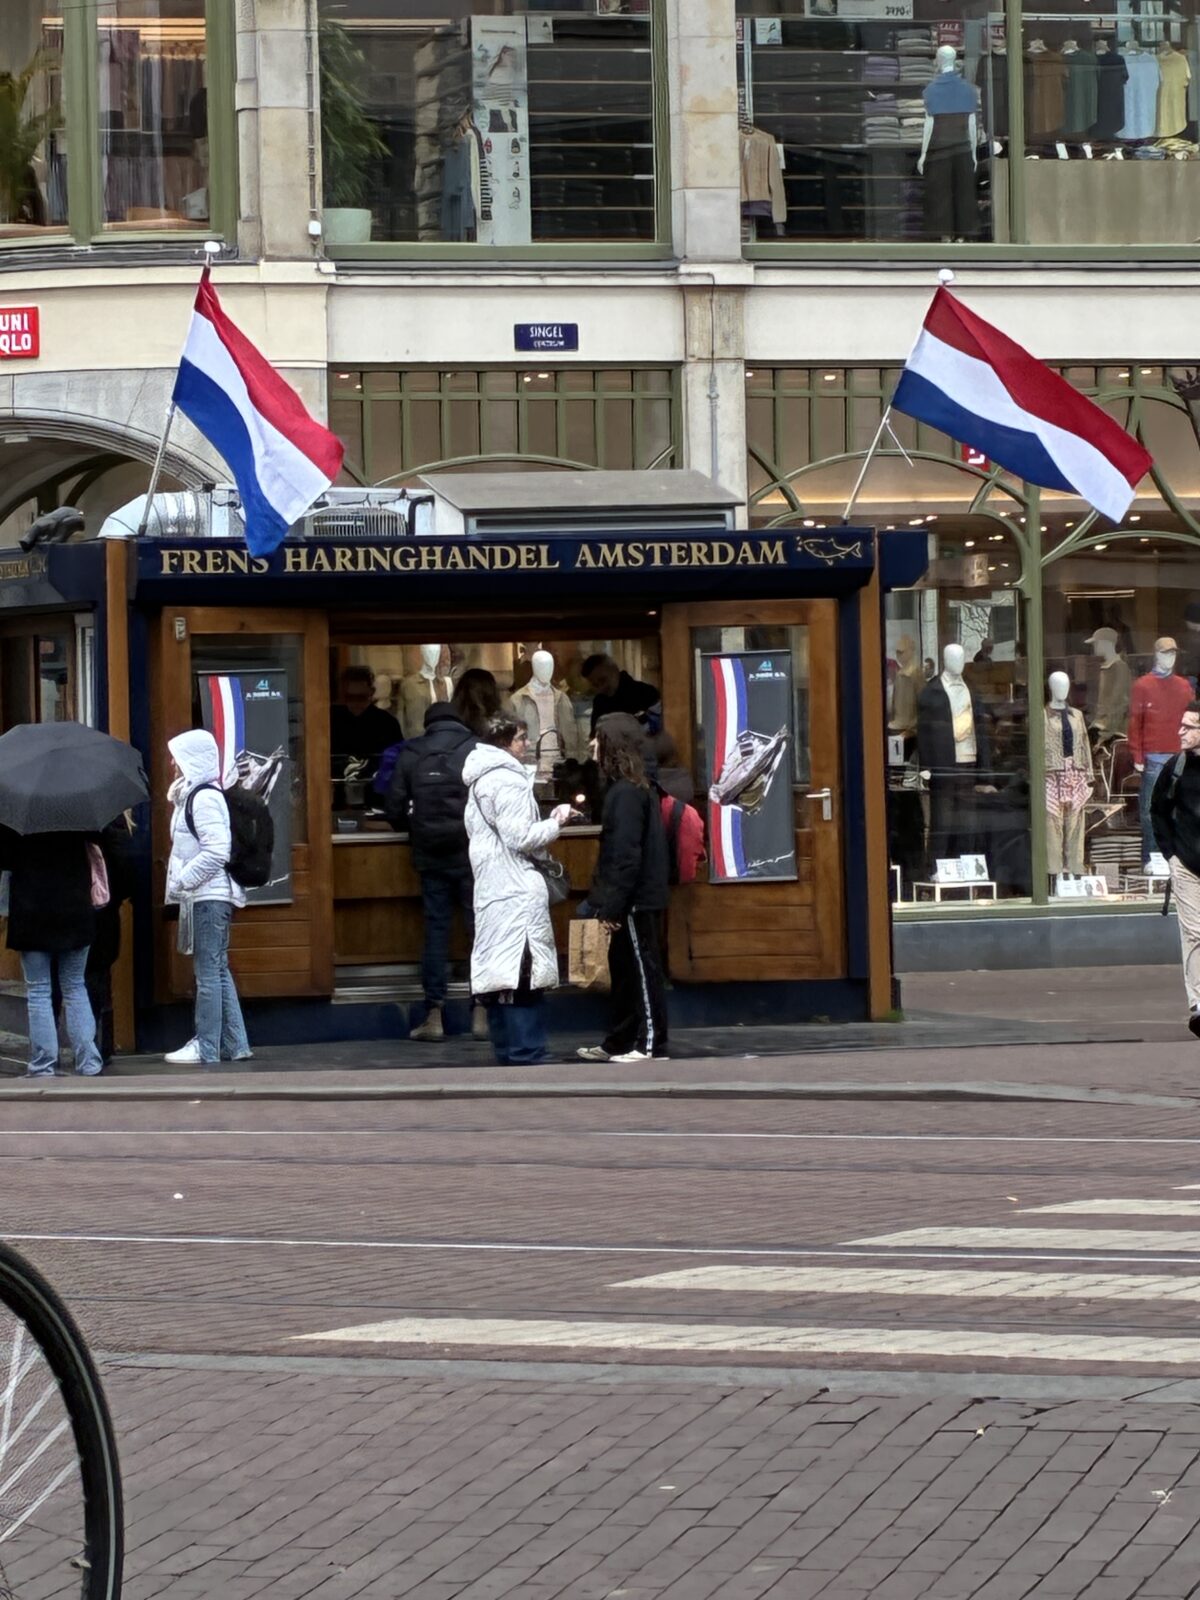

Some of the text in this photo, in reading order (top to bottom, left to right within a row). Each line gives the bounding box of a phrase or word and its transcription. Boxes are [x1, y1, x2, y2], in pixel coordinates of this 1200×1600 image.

[0, 313, 29, 331] UNI
[530, 326, 564, 338] SINGEL
[0, 333, 32, 354] QLO
[160, 540, 788, 574] FRENS HARINGHANDEL AMSTERDAM
